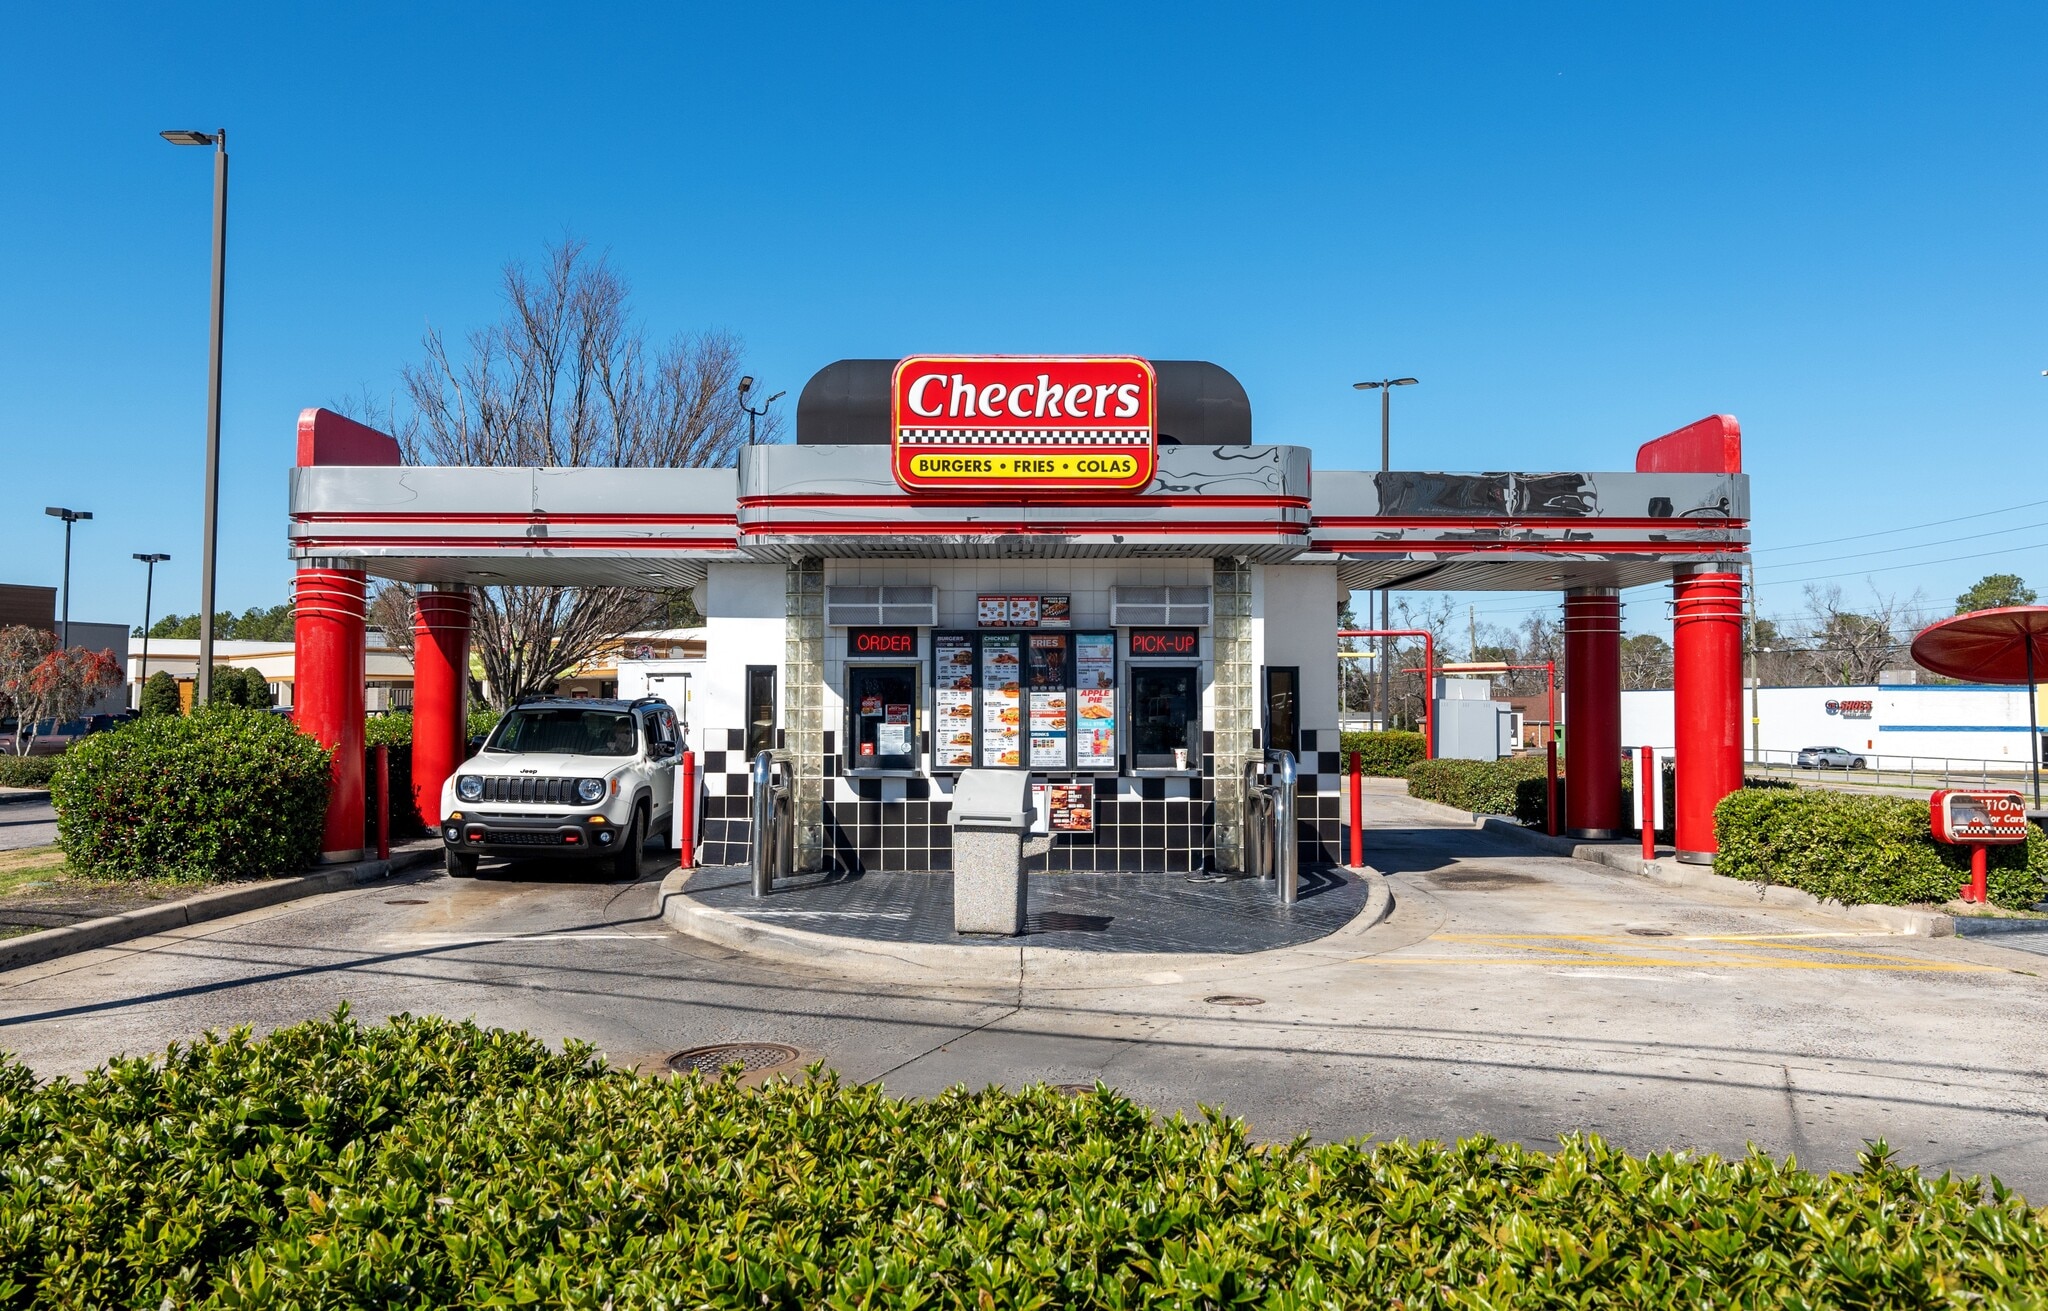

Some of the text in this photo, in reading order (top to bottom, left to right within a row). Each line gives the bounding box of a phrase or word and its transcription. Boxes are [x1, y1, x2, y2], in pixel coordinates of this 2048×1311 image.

[908, 374, 1140, 418] Checkers
[919, 460, 1131, 473] BURGERS FRIES COLAS
[857, 634, 911, 651] ORDER
[1030, 639, 1059, 647] FRIES
[1132, 635, 1195, 652] PICK-UP
[1080, 689, 1110, 697] APPLE
[1840, 701, 1873, 711] SHOES
[1989, 814, 2001, 823] or
